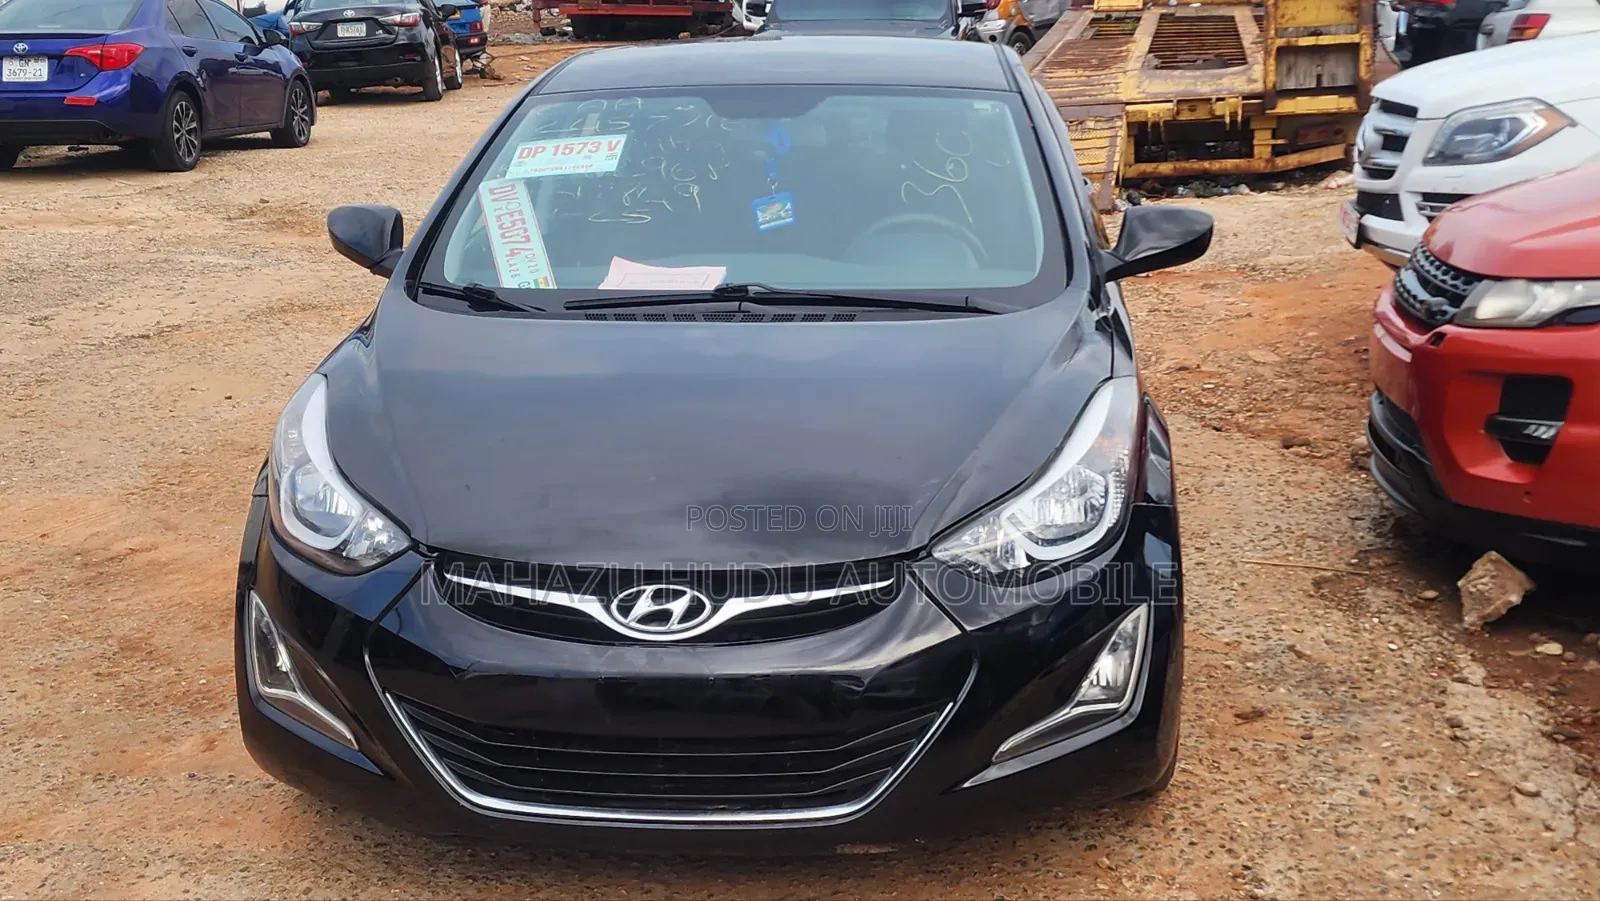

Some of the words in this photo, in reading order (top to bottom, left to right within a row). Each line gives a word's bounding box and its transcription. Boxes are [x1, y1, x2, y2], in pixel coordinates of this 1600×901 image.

[6, 68, 43, 77] 3679-21
[517, 145, 547, 160] DP
[551, 140, 603, 156] 1573
[607, 139, 622, 152] V
[488, 183, 520, 203] DV
